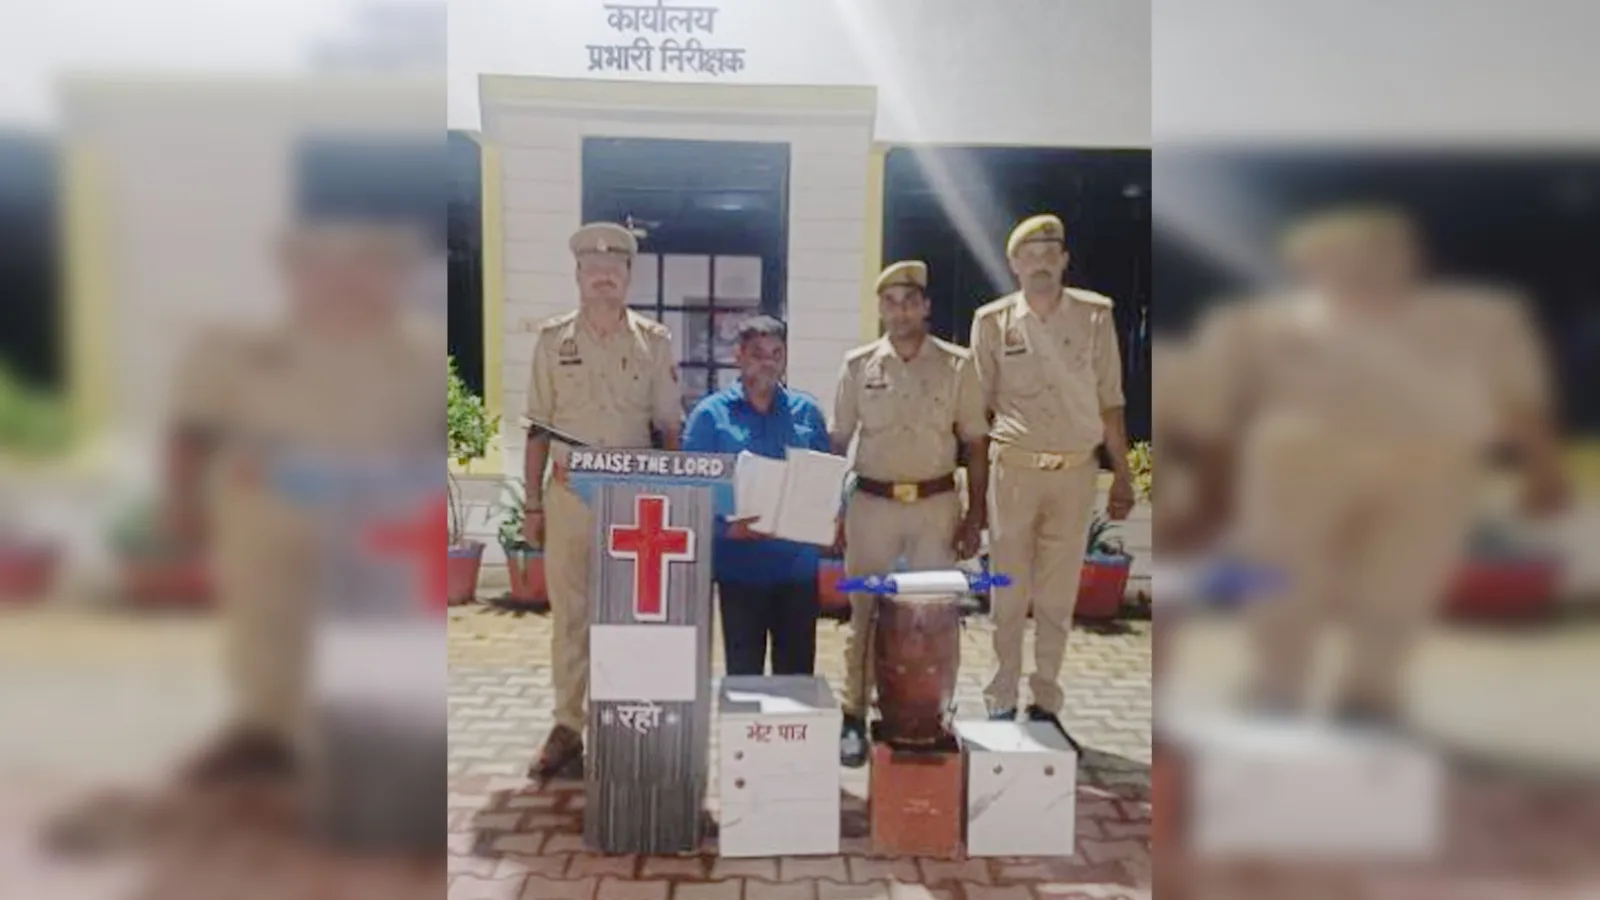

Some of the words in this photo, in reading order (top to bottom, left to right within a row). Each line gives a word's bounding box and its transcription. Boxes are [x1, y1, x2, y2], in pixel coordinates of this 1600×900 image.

[585, 37, 655, 72] प्रभारी
[658, 37, 746, 76] निरीक्षक
[571, 452, 631, 473] PRAISE
[637, 454, 669, 475] THE
[673, 456, 723, 476] LORD
[777, 723, 808, 742] पात्र
